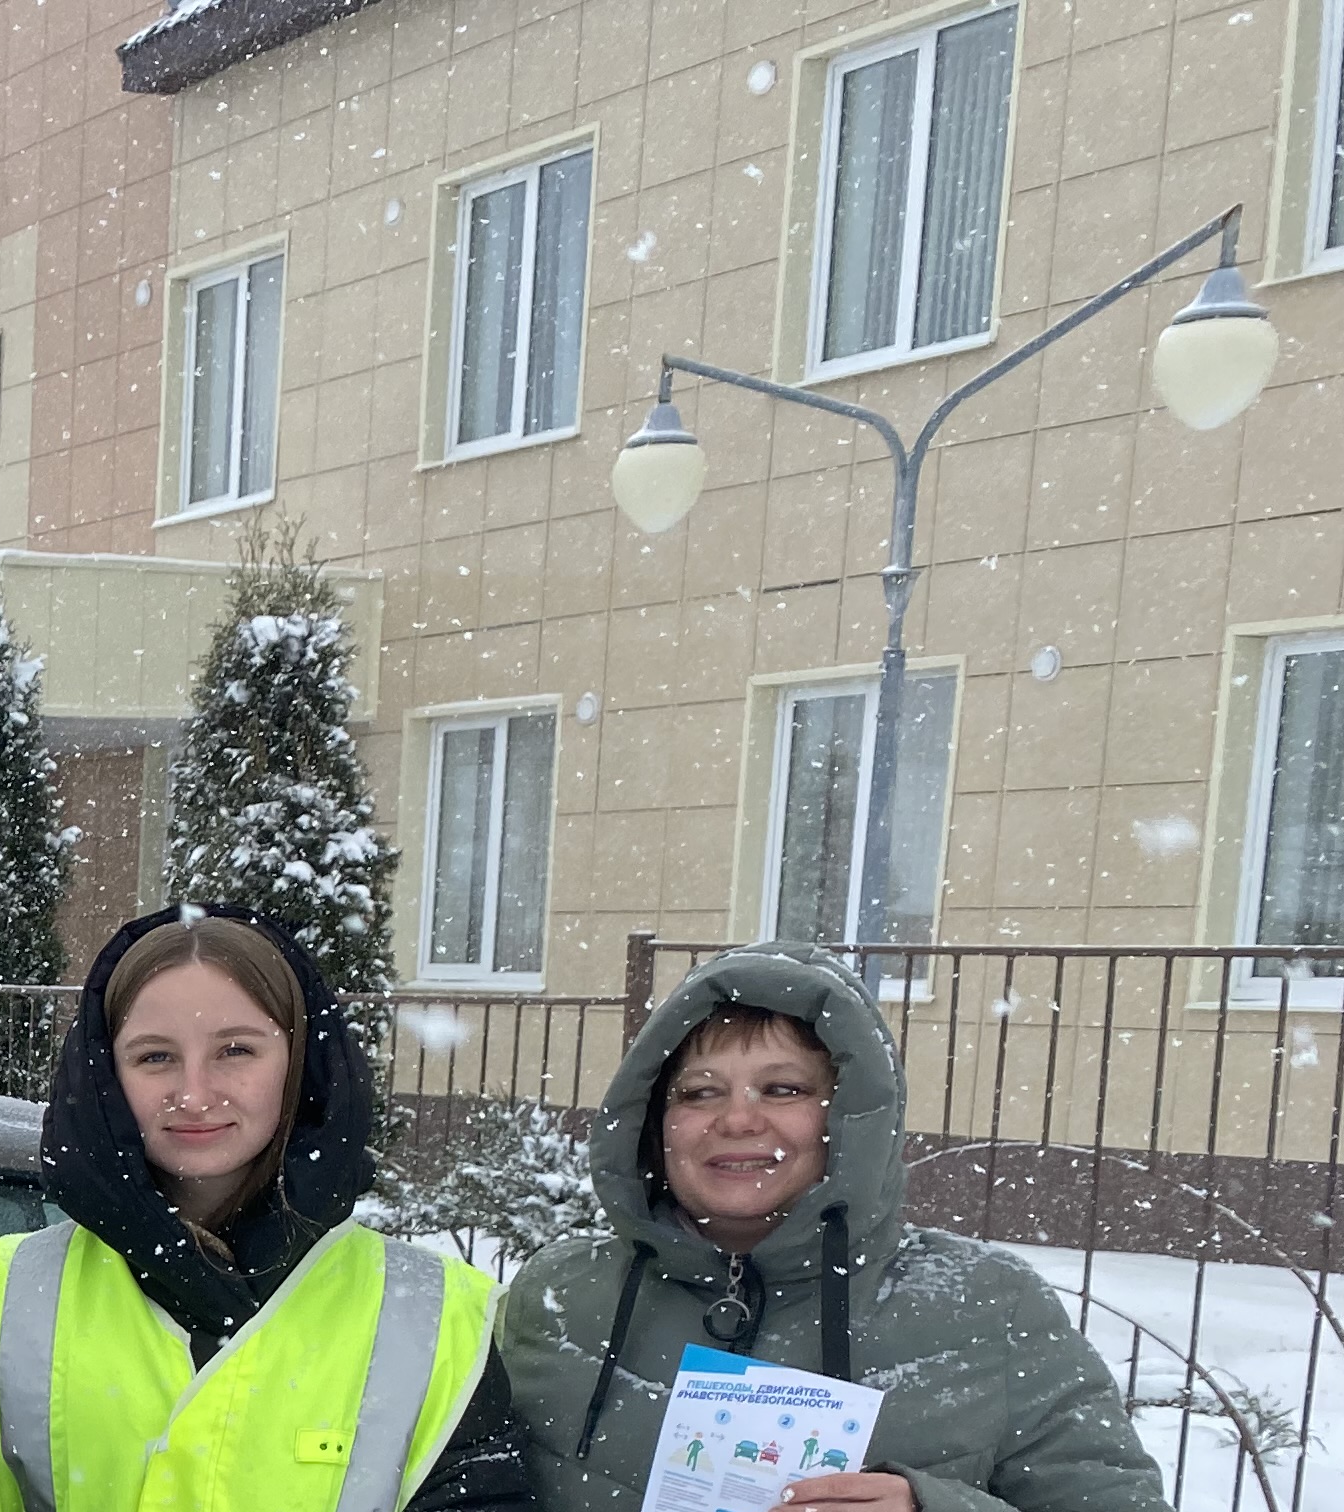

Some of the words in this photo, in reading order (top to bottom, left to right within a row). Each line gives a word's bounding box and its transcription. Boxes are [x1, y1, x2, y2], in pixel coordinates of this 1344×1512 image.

[676, 1389, 844, 1409] #НАВСТРЕЧУБЕЗОПАСНОСТИ!
[687, 1379, 754, 1393] ПЕШЕХОДЫ,
[756, 1384, 832, 1399] ДВИГАЙТЕСЬ
